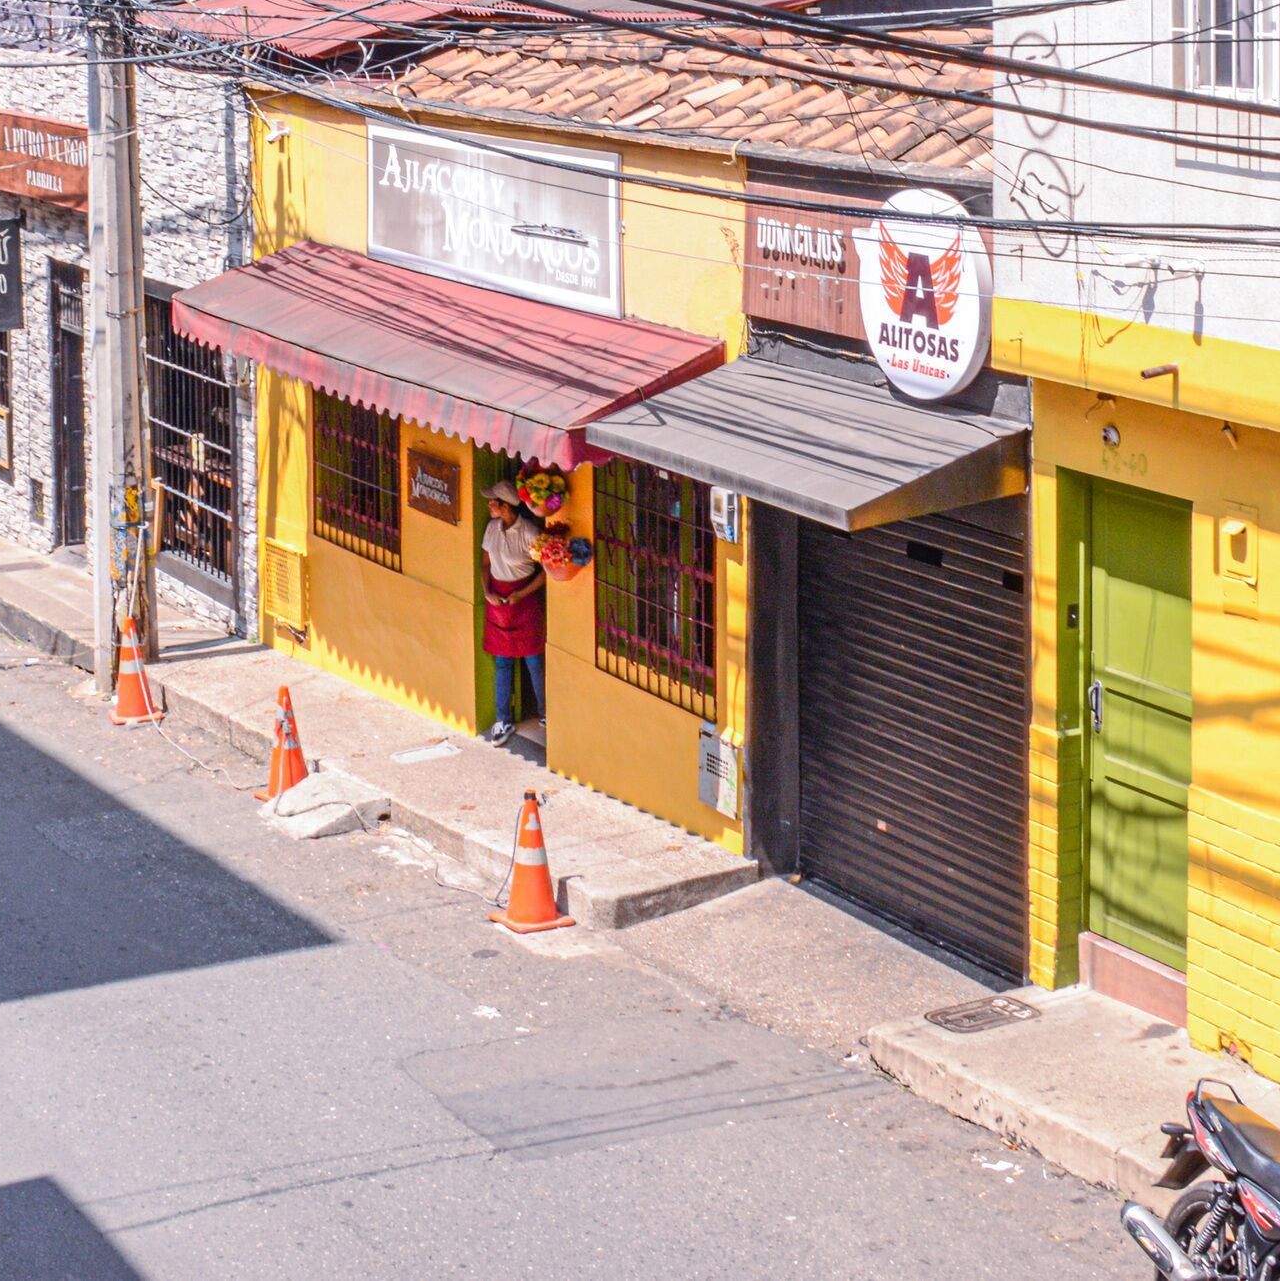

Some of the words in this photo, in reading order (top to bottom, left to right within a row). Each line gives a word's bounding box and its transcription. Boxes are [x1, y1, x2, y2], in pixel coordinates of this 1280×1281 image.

[12, 127, 45, 158] PURO
[26, 169, 63, 193] PARRILLA
[581, 274, 597, 290] 1991
[878, 322, 960, 363] ALITOSAS
[891, 353, 910, 370] Las
